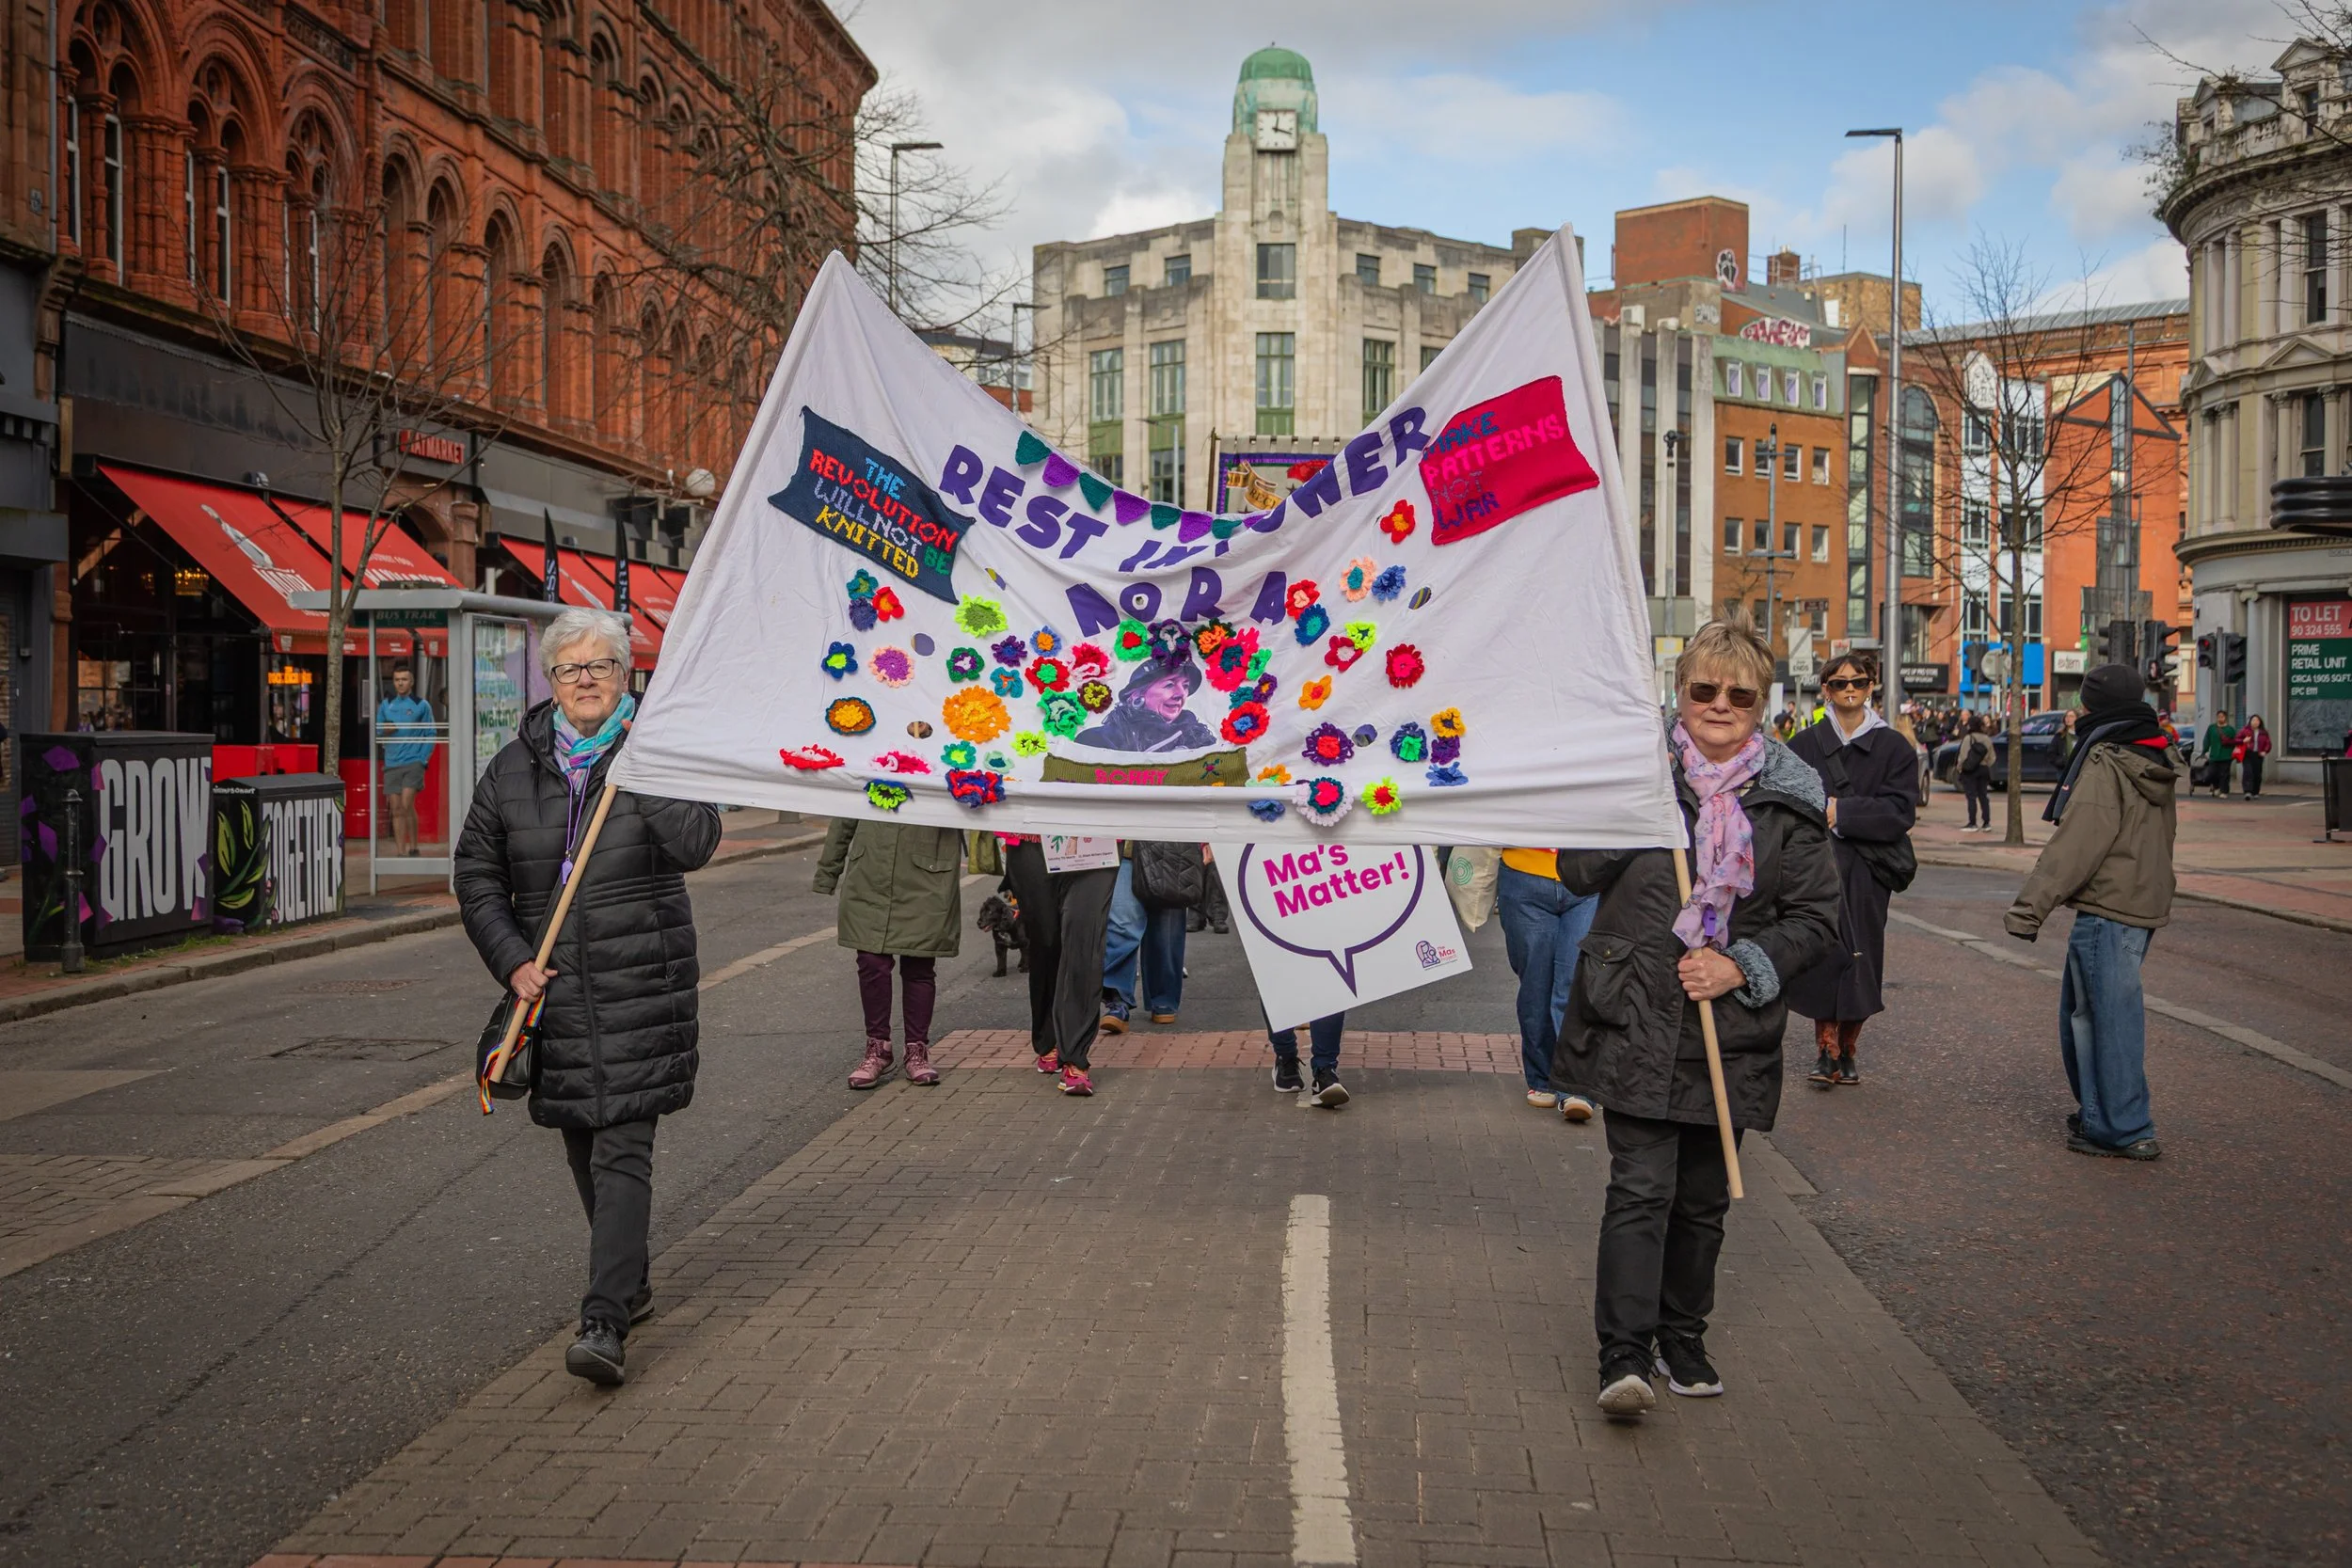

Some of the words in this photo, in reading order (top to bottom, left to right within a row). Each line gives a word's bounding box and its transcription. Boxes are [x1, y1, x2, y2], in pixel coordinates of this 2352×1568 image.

[1423, 411, 1500, 461] MAKE
[1423, 414, 1565, 487] PATTERNS
[865, 456, 906, 499] THE
[939, 445, 1109, 559] REST
[1119, 532, 1210, 572] IN
[1216, 406, 1431, 557] OWER
[1432, 469, 1483, 506] NOT
[809, 449, 959, 552] REVOLUTION
[1437, 491, 1500, 531] WAR
[814, 478, 869, 525] WILL
[873, 513, 922, 556] NOT
[924, 546, 952, 576] BE
[816, 505, 919, 578] KNITTED
[376, 610, 400, 620] BUS
[405, 610, 437, 620] TRAK
[1066, 566, 1288, 638] NORA
[2291, 606, 2311, 622] TO
[2315, 605, 2342, 622] LET
[2292, 626, 2303, 637] 90
[2305, 625, 2323, 636] 324
[2324, 624, 2342, 635] 555
[2292, 644, 2319, 656] PRIME
[2292, 657, 2322, 670] RETAIL
[2324, 657, 2347, 669] UNIT
[2292, 674, 2312, 683] CIRCA
[479, 707, 519, 731] waiting
[1094, 768, 1169, 784] SORRY
[100, 756, 212, 922] GROW
[262, 798, 343, 924] TOGETHER
[1263, 845, 1349, 887] Ma's
[1273, 851, 1410, 918] Matter!
